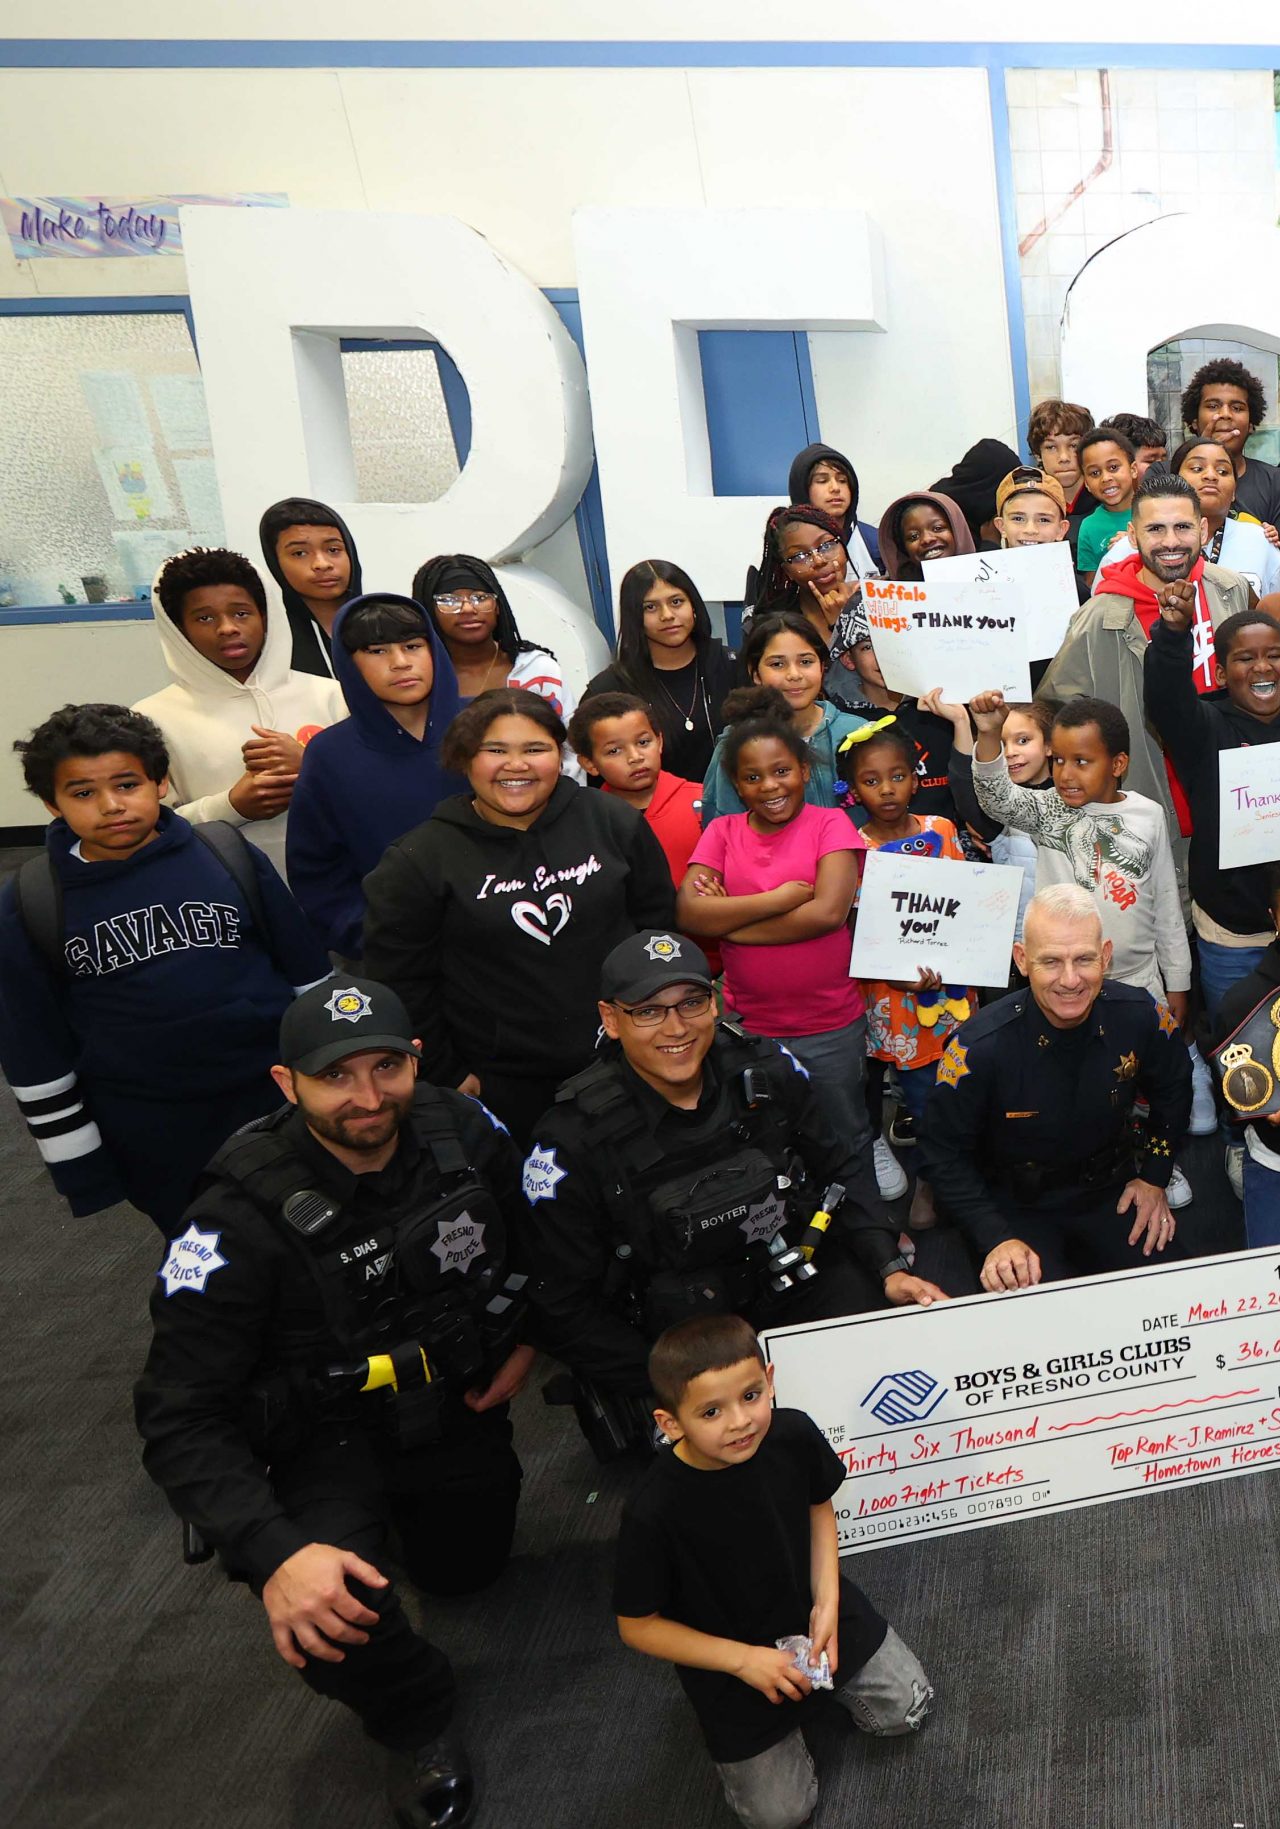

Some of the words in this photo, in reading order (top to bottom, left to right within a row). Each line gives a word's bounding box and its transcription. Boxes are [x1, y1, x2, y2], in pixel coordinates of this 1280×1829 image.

[21, 207, 89, 245] Make
[97, 202, 166, 249] today
[865, 581, 927, 602] Buffalo
[912, 612, 973, 629] THANK
[476, 874, 496, 900] I
[494, 878, 526, 894] am
[1104, 870, 1138, 911] ROAR
[891, 891, 961, 919] THANK
[64, 901, 241, 977] SAVAGE
[528, 1158, 555, 1175] FRESNO
[524, 1173, 551, 1193] POLICE
[700, 1204, 748, 1231] BOYTER
[751, 1203, 778, 1225] FRESNO
[752, 1213, 782, 1237] POLICE
[441, 1225, 475, 1247] FRESNO
[178, 1240, 213, 1262] FRESNO
[340, 1252, 352, 1263] S.
[353, 1239, 378, 1258] DIAS
[444, 1238, 480, 1264] POLICE
[168, 1258, 204, 1282] POLICE
[1142, 1314, 1180, 1332] DATE
[1187, 1299, 1228, 1323] March
[1237, 1297, 1262, 1313] 22,
[954, 1366, 1017, 1392] BOYS
[1022, 1363, 1041, 1380] &
[1046, 1349, 1114, 1375] GIRLS
[1119, 1335, 1191, 1362] CLUBS
[1215, 1353, 1226, 1371] $
[965, 1390, 995, 1407] OF
[1002, 1373, 1091, 1401] FRESNO
[1097, 1355, 1185, 1383] COUNTY
[828, 1425, 846, 1436] THE
[832, 1435, 845, 1444] OF
[910, 1433, 941, 1460] Six
[949, 1416, 1040, 1454] Thousand
[858, 1494, 898, 1517] 1,000
[954, 1465, 1024, 1495] Tickets
